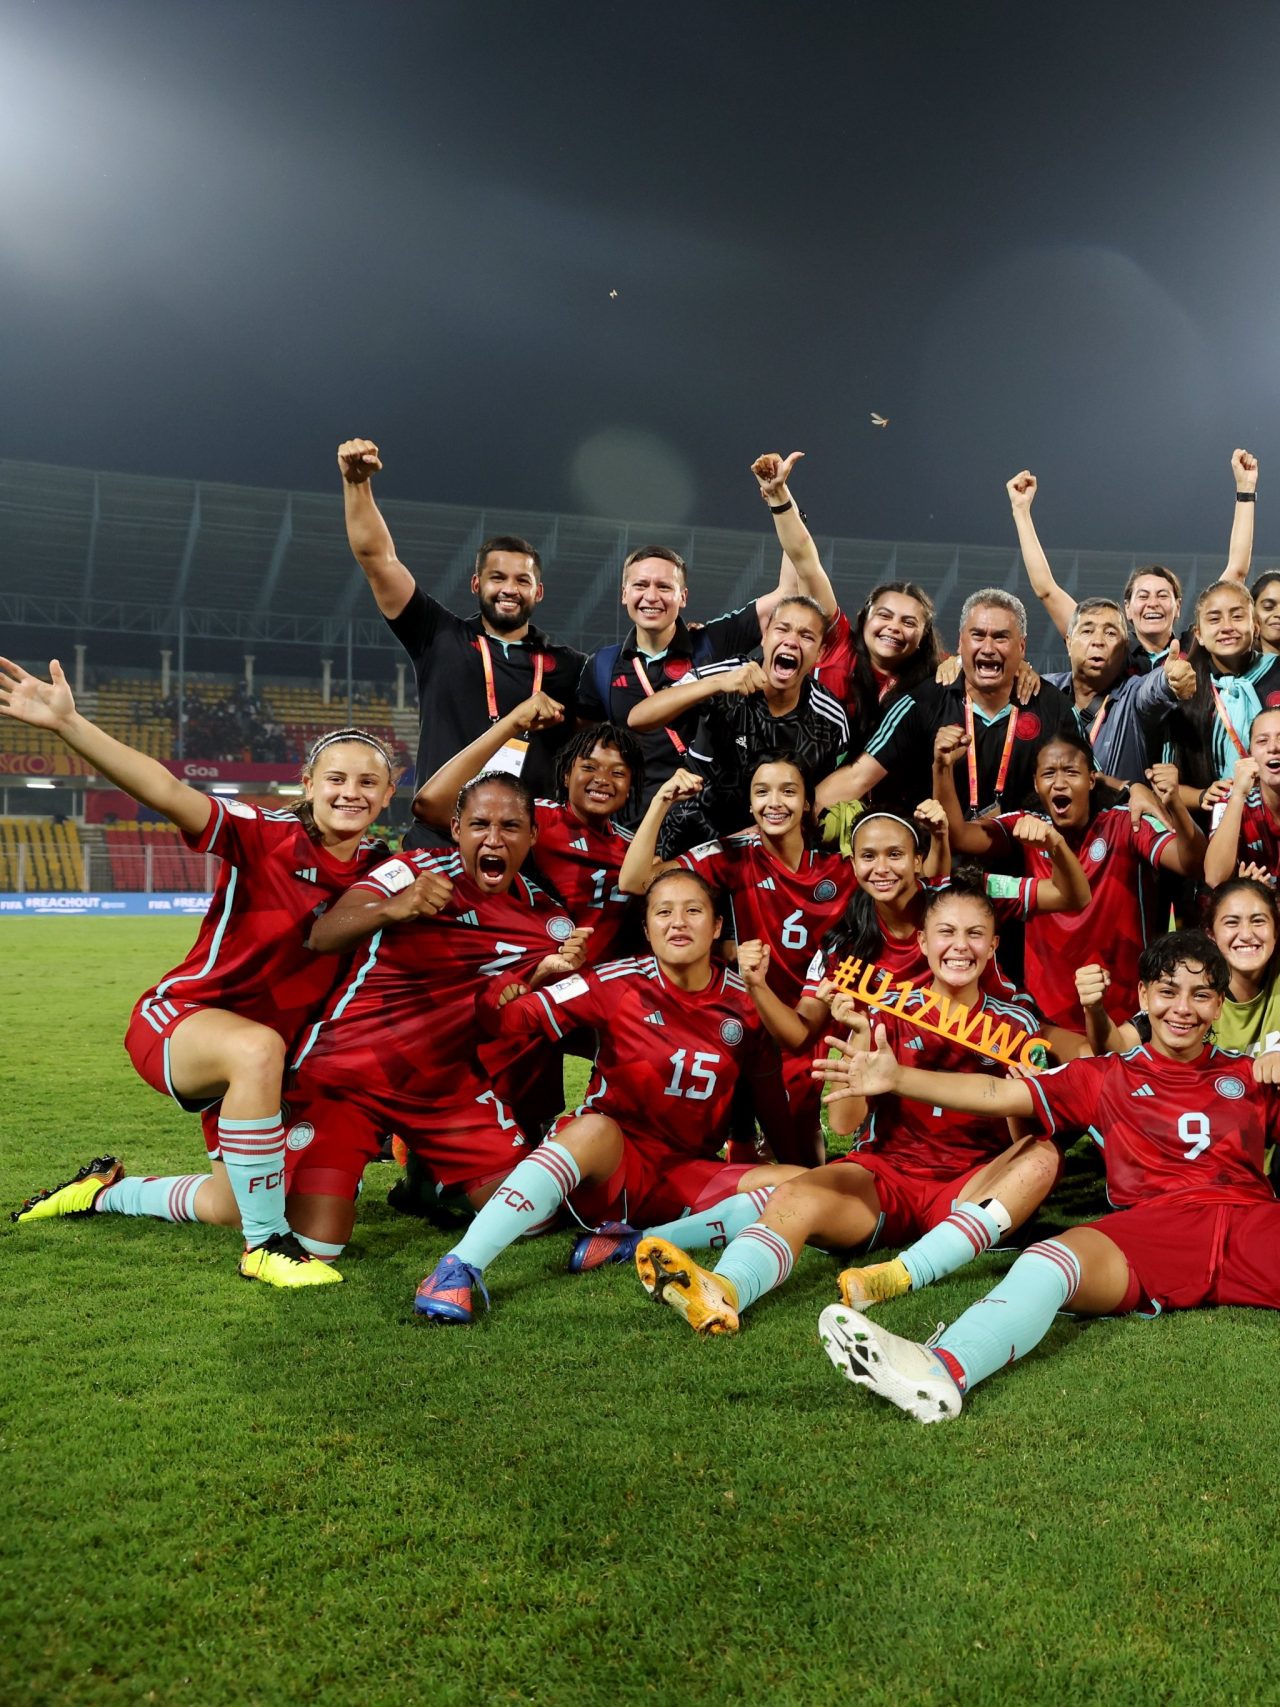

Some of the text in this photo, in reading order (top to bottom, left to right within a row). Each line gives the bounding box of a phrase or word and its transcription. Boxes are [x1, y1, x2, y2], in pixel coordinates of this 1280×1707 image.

[184, 763, 219, 778] Goa
[0, 901, 23, 910] FIFA
[25, 896, 101, 909] #REACHOUT
[148, 900, 172, 910] FIFA
[781, 909, 808, 950] 6
[478, 941, 527, 976] 2
[833, 954, 1053, 1072] #U17WWC
[664, 1048, 721, 1101] 15
[1177, 1111, 1212, 1161] 9
[493, 1186, 535, 1213] FCF
